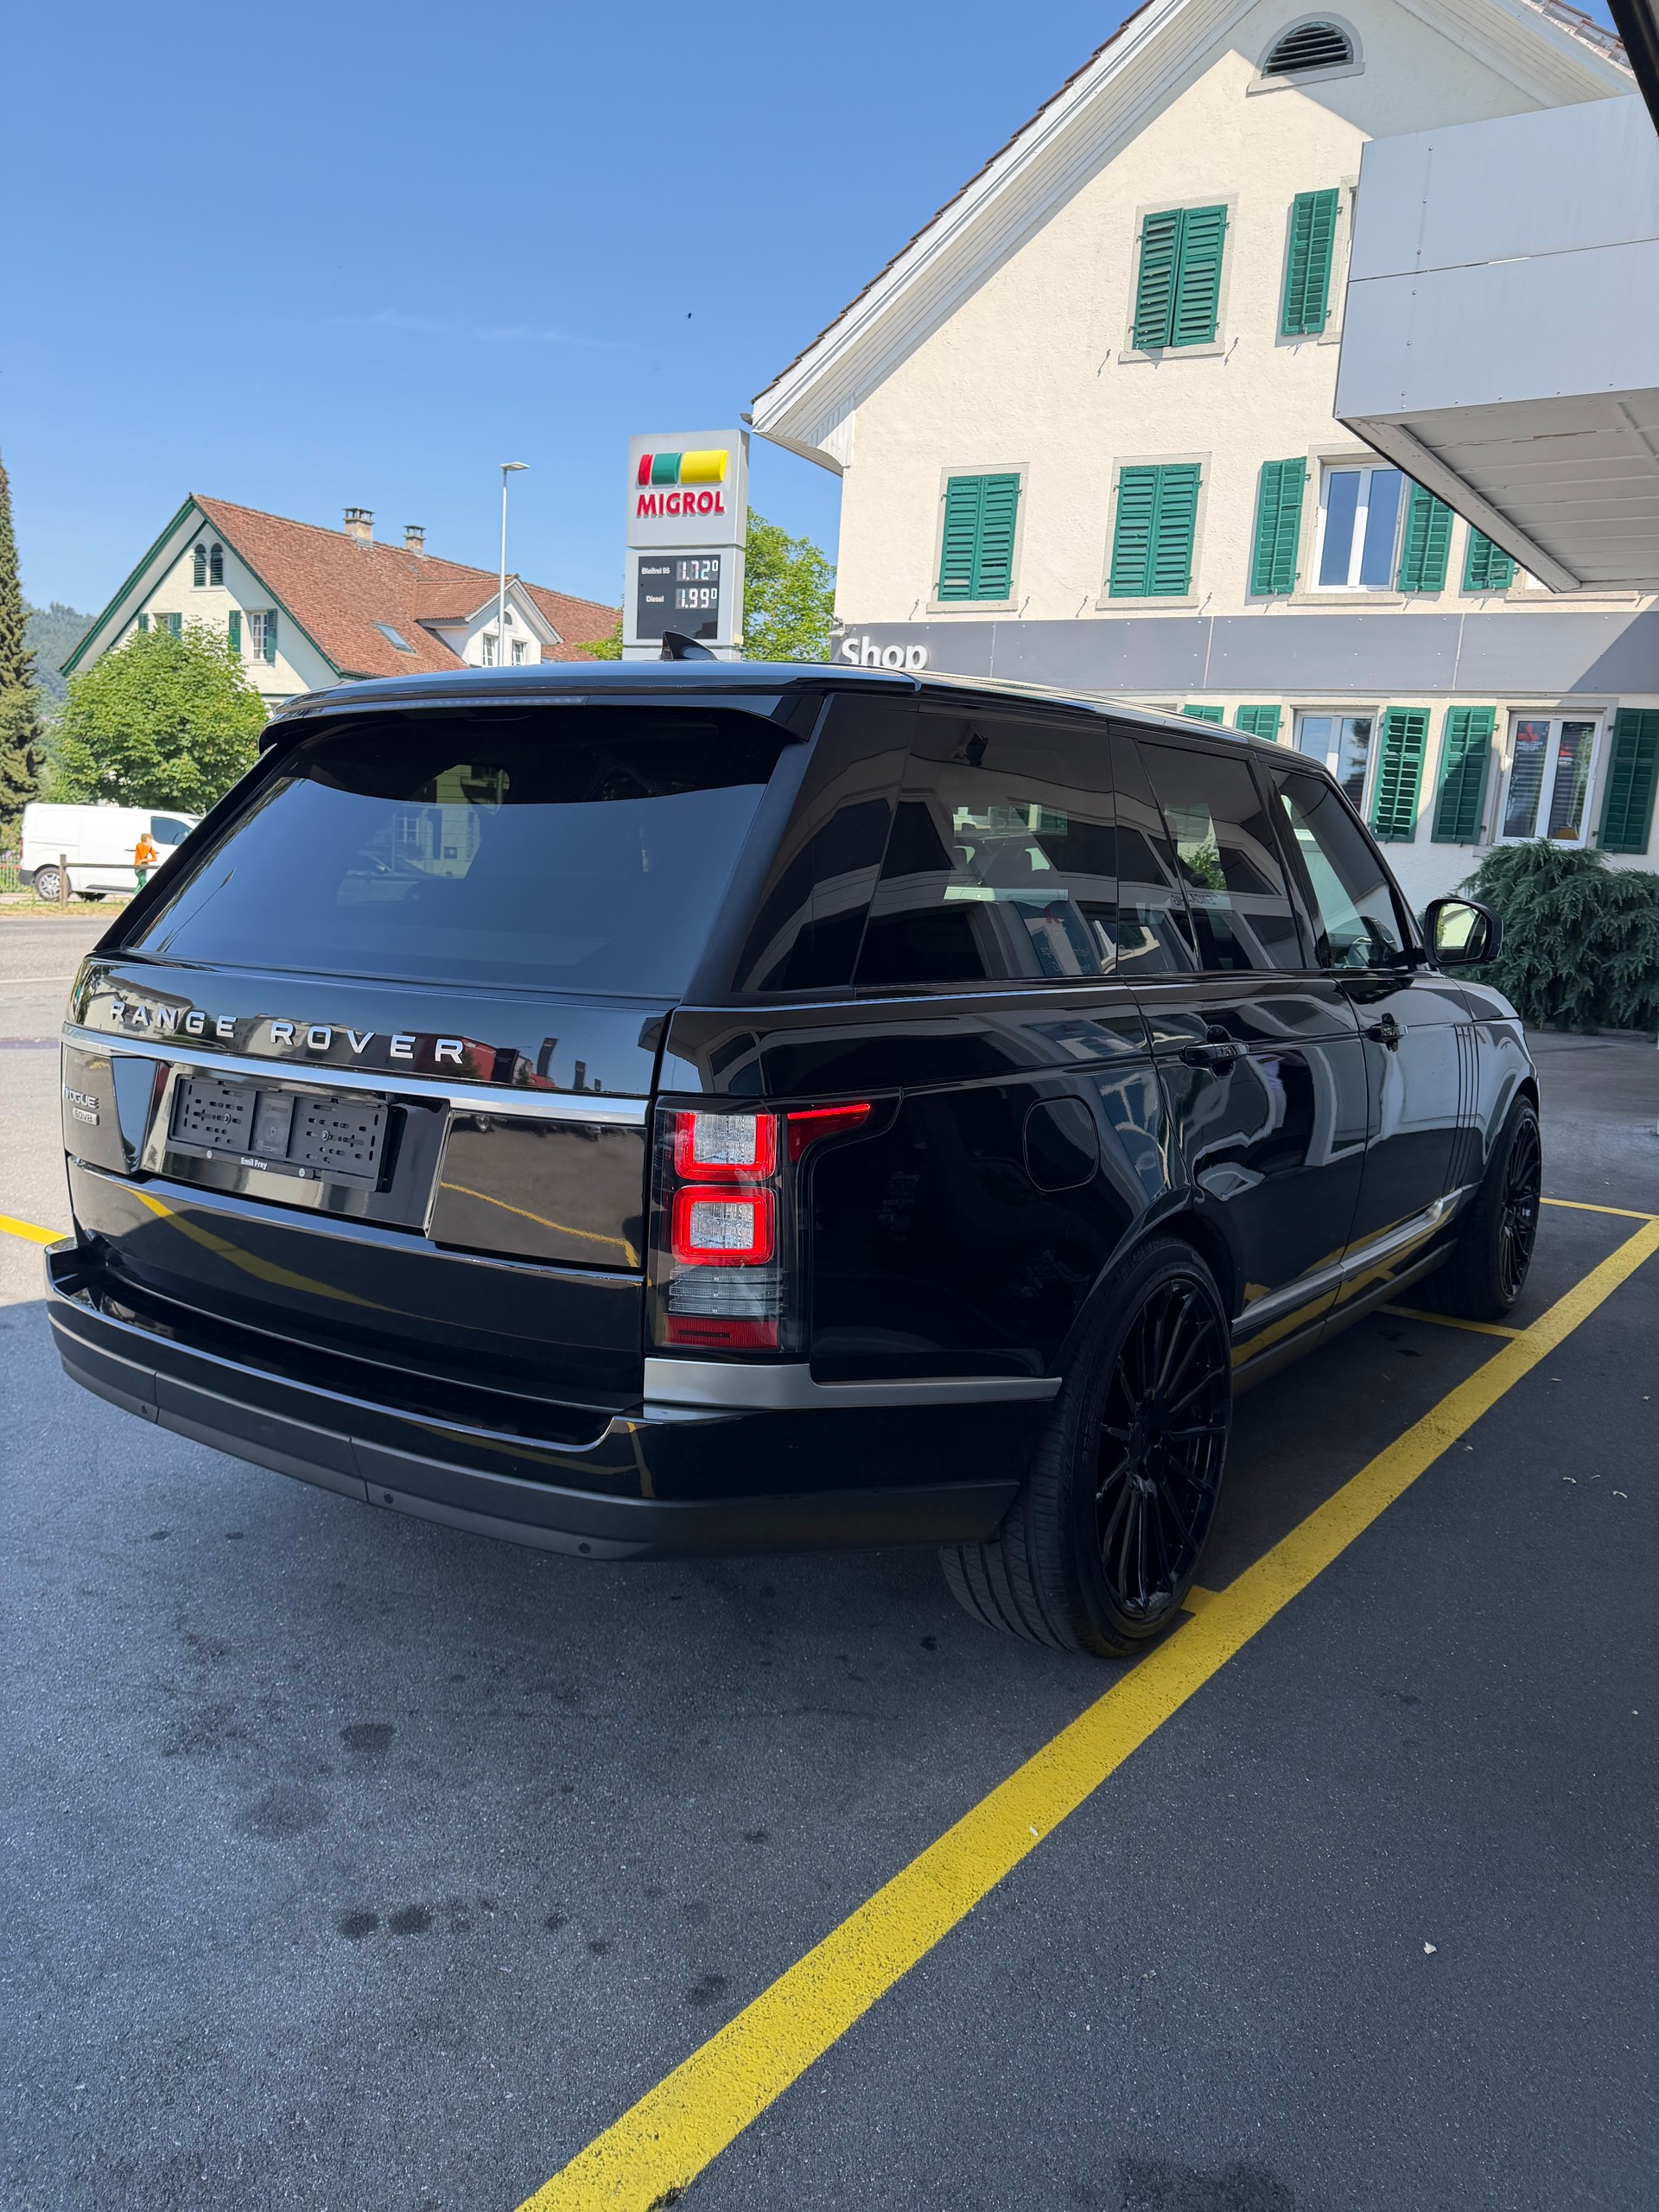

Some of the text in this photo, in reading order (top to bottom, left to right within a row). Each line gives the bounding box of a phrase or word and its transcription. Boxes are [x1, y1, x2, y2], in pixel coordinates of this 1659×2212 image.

[636, 491, 725, 516] MIGROL
[645, 594, 664, 603] Diesel
[842, 636, 928, 670] Shop
[110, 1000, 465, 1065] RANGE ROVER
[65, 1086, 99, 1109] VOGUE
[240, 1156, 268, 1171] Emil Frey
